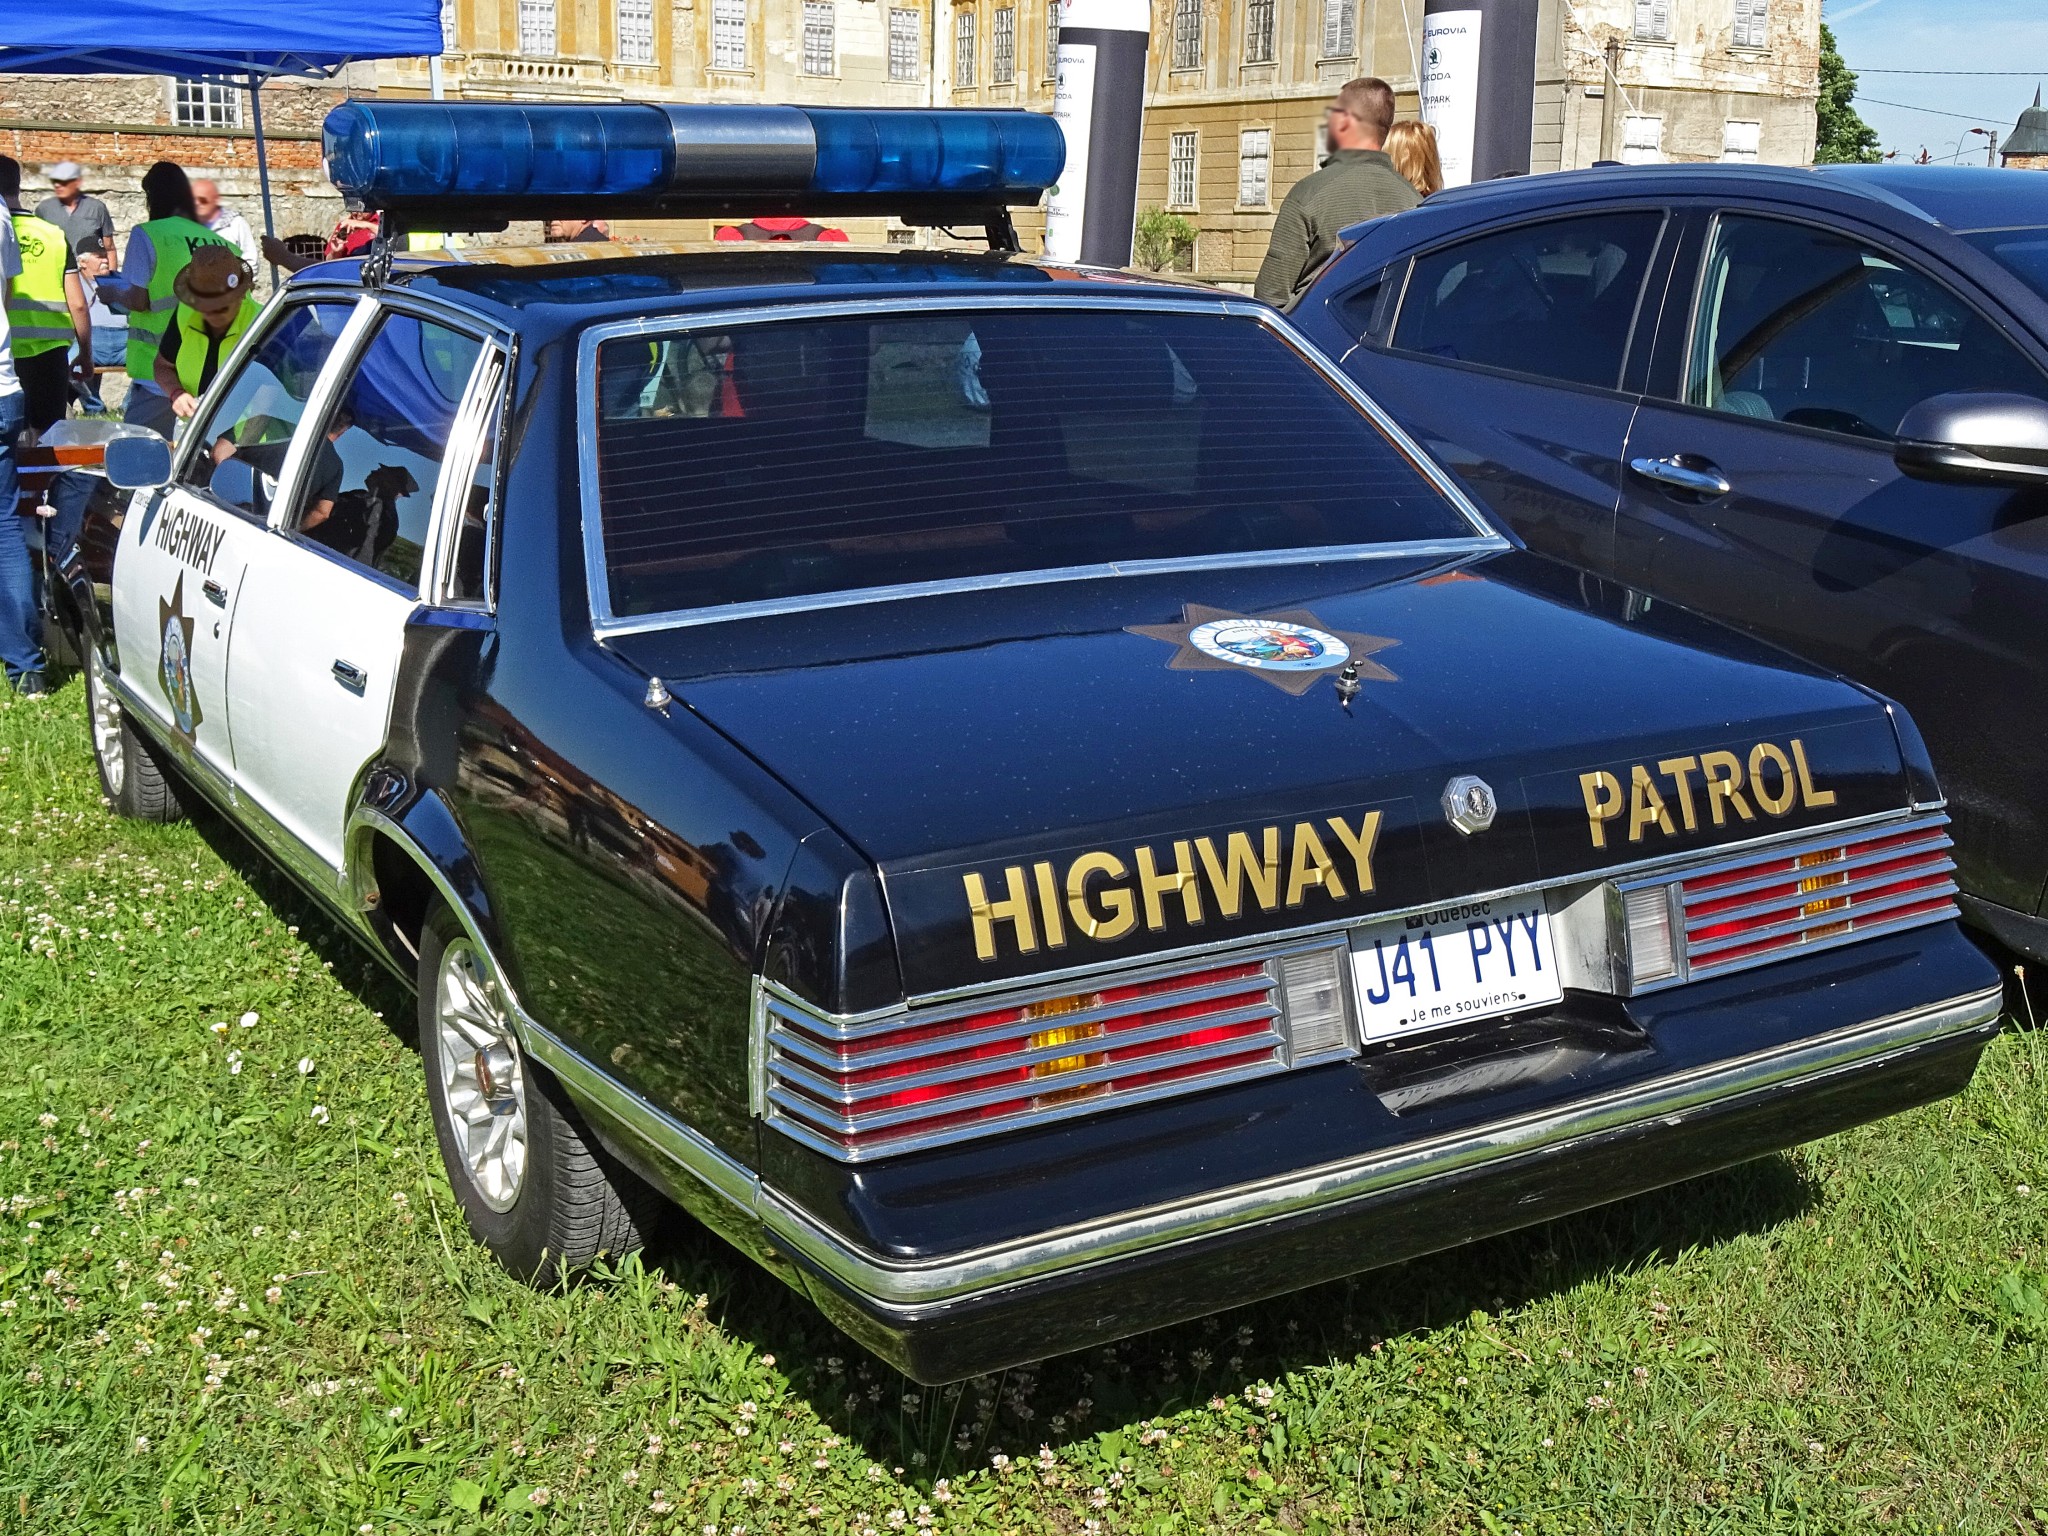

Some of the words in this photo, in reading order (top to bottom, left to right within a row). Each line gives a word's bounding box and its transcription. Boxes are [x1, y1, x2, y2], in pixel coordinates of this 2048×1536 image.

[1428, 27, 1467, 37] EUROVIA
[155, 501, 226, 576] HIGHWAY
[1210, 619, 1304, 632] HIGHWAY
[962, 810, 1385, 961] HIGHWAY
[1578, 738, 1837, 848] PATROL
[1367, 930, 1442, 1005] J41
[1466, 909, 1542, 984] PYY
[1410, 1009, 1426, 1023] Je
[1431, 1003, 1451, 1018] me
[1456, 990, 1518, 1013] souviens
